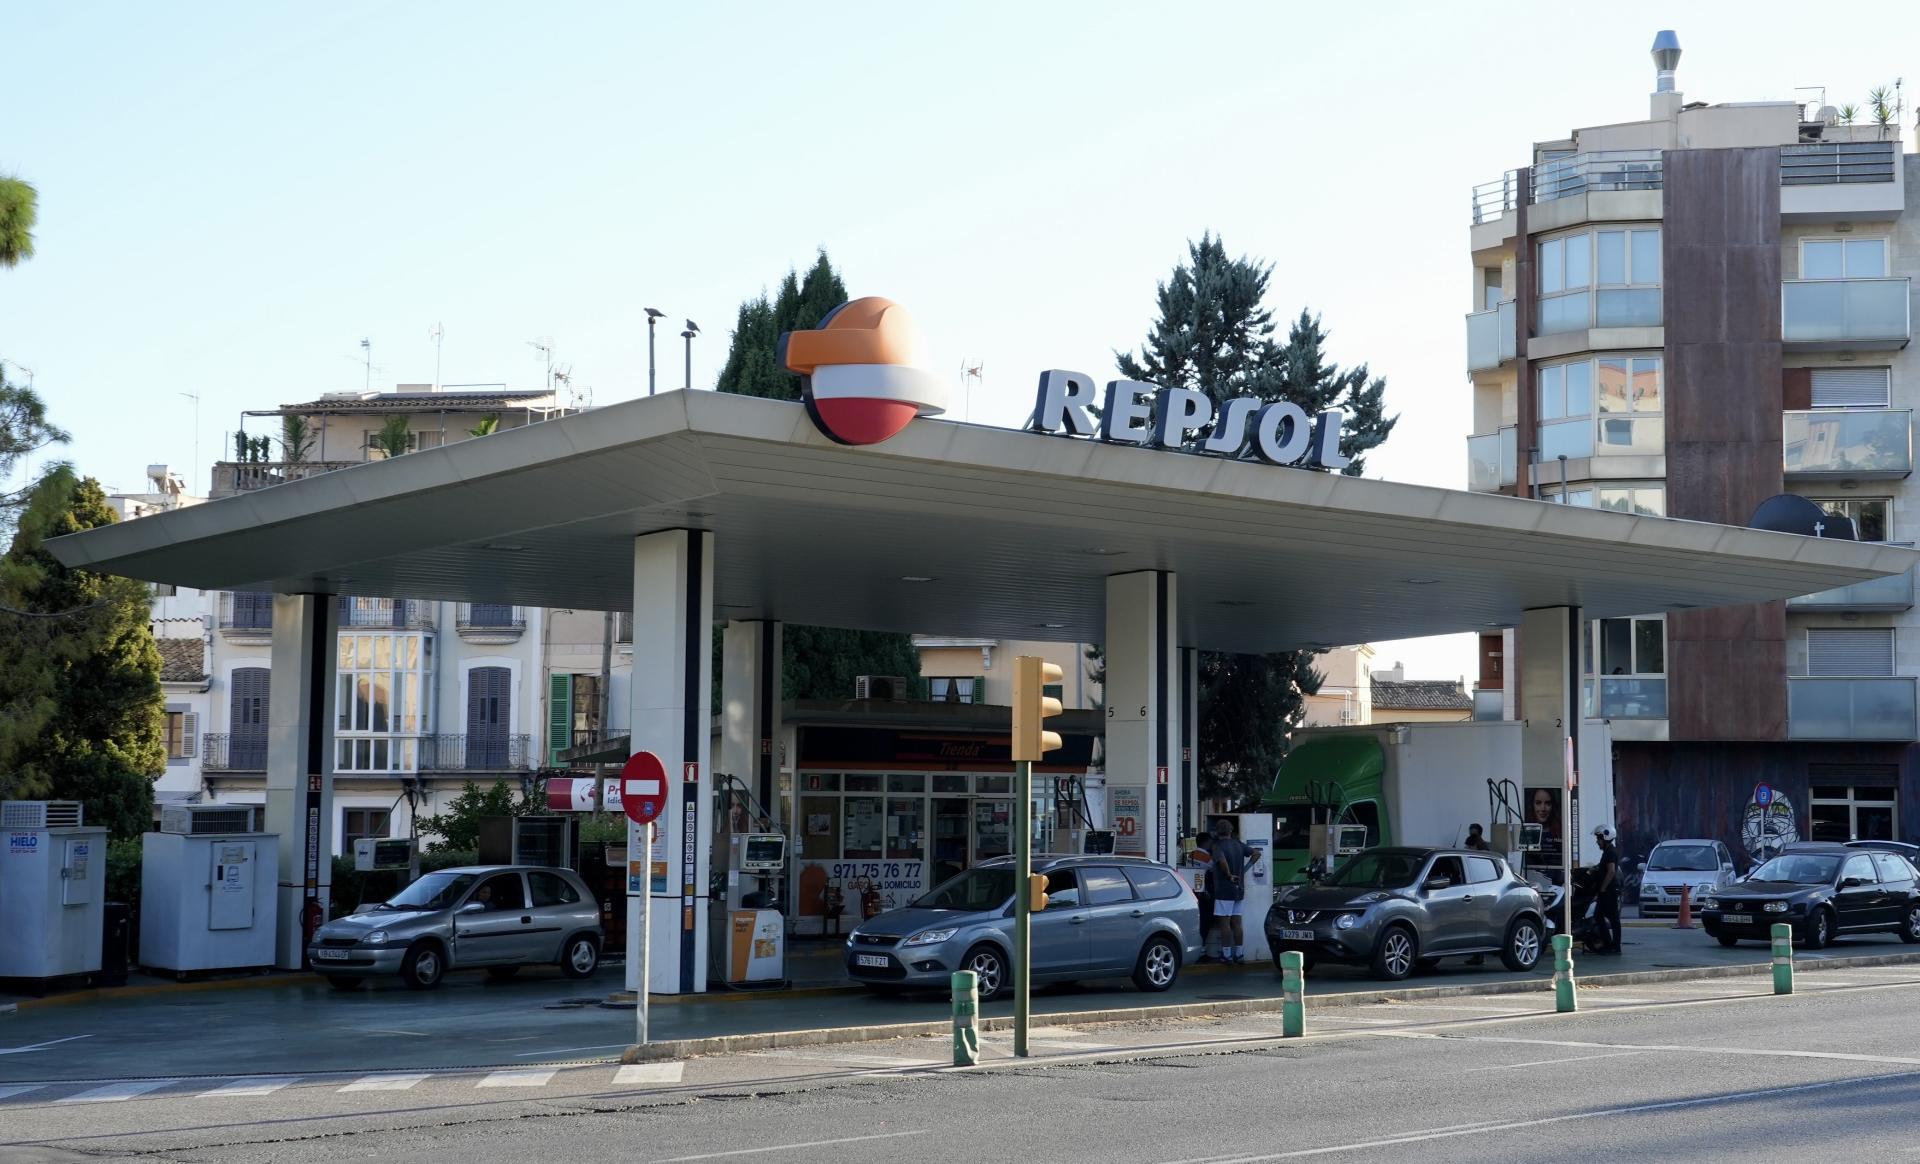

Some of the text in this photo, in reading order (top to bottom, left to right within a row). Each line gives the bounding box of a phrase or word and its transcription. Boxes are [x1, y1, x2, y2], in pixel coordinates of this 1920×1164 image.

[1033, 369, 1350, 469] REPSOL
[1108, 706, 1114, 717] 5
[1140, 705, 1146, 717] 6
[1524, 718, 1529, 728] 1
[1556, 718, 1562, 728] 2
[941, 741, 980, 756] Tienda
[607, 785, 621, 795] Pr
[1116, 817, 1136, 836] 30
[10, 836, 38, 847] HIELO
[834, 863, 921, 878] 971 75 76 77
[884, 880, 921, 889] DOMICILIO
